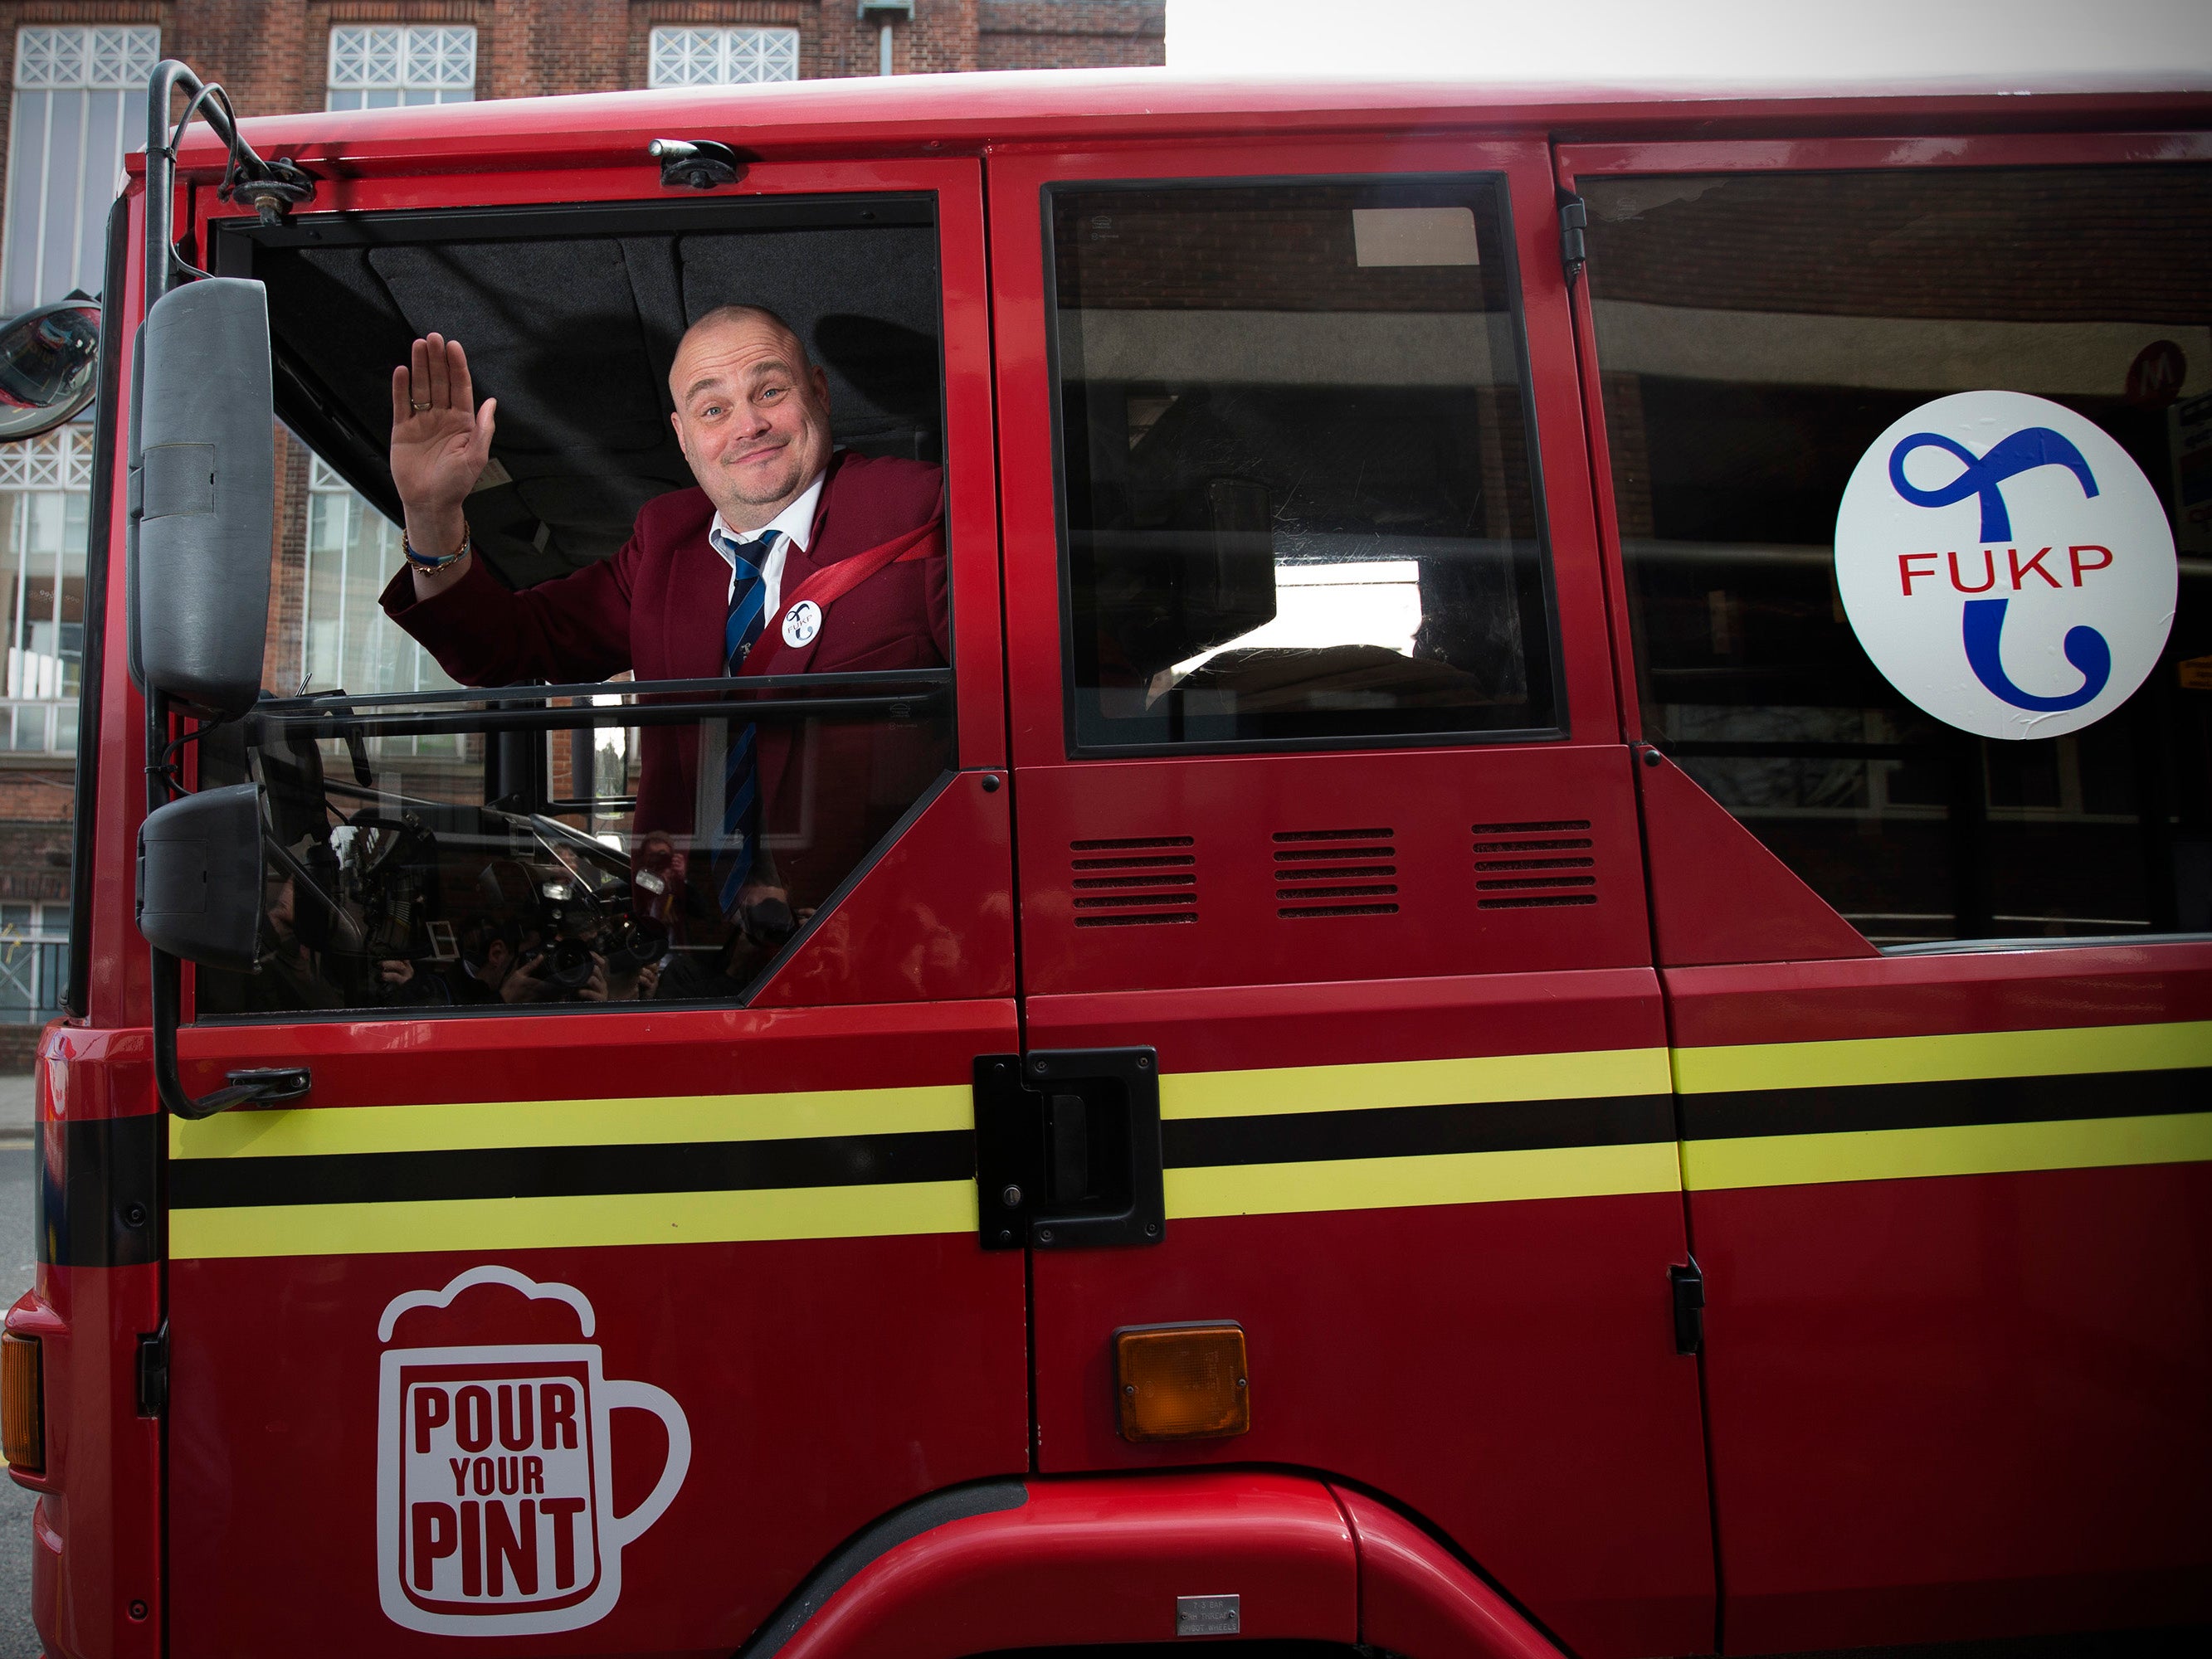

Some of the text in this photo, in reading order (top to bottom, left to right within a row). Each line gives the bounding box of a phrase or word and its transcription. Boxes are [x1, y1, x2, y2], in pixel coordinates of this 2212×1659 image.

[1898, 544, 2113, 596] FUKP
[787, 615, 812, 634] FUKP
[414, 1384, 578, 1453] POUR
[450, 1456, 544, 1496] YOUR
[412, 1496, 586, 1597] PINT
[1208, 1623, 1237, 1632] WHEELS
